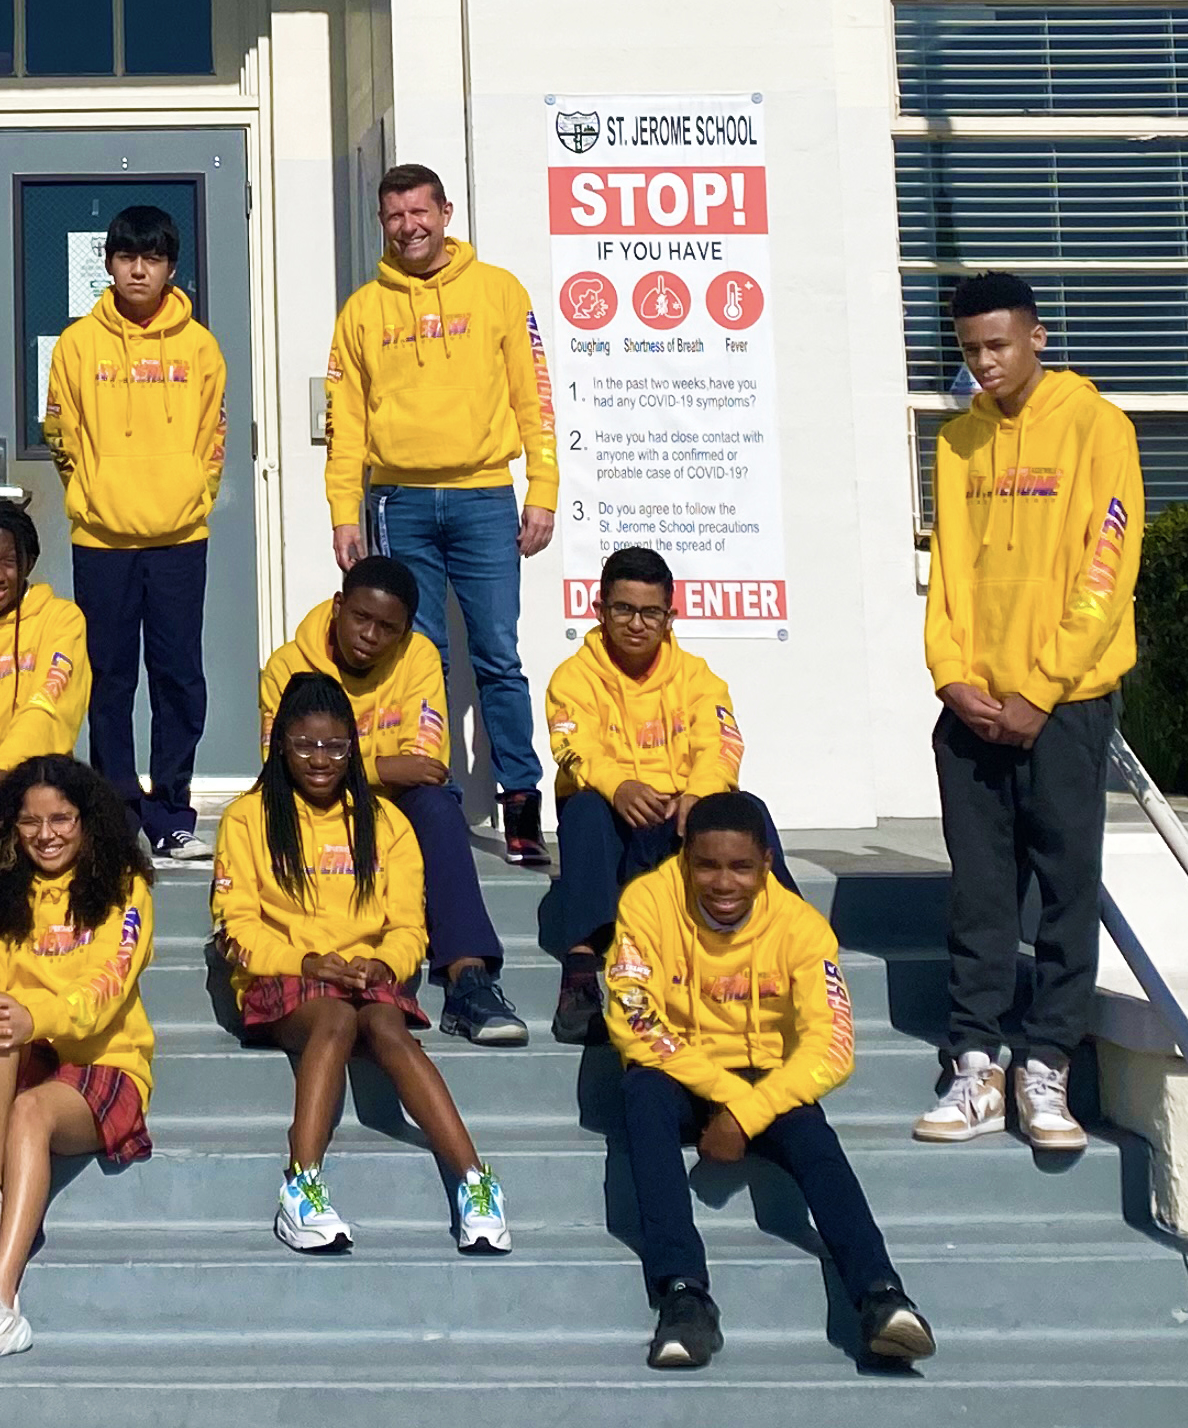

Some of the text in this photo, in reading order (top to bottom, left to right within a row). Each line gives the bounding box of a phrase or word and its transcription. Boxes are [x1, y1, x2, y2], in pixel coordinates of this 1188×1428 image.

[606, 116, 628, 146] ST.
[631, 115, 692, 146] JEROME
[695, 115, 758, 145] SCHOOL
[570, 172, 746, 227] STOP!
[597, 241, 723, 261] IF YOU HAVE
[570, 337, 610, 357] Coughing
[623, 337, 705, 353] Shortness of Breath
[725, 337, 748, 353] Fever
[593, 376, 603, 389] In
[606, 376, 623, 389] the
[626, 378, 648, 393] past
[651, 377, 669, 390] two
[737, 379, 757, 393] you
[593, 394, 757, 411] had any COVID-19 symptoms?
[569, 429, 588, 451] 2.
[595, 430, 764, 446] Have you had close contact with
[596, 448, 738, 464] anyone with a confirmed or
[597, 466, 749, 482] probable case of COVID-19?
[572, 500, 591, 521] 3.
[598, 501, 736, 518] Do you agree to follow the
[616, 520, 656, 533] Jerome
[659, 519, 695, 533] School
[698, 521, 760, 536] precautions
[600, 538, 610, 551] to
[655, 538, 673, 551] the
[676, 538, 712, 554] spread
[714, 537, 726, 551] of
[684, 582, 780, 617] ENTER
